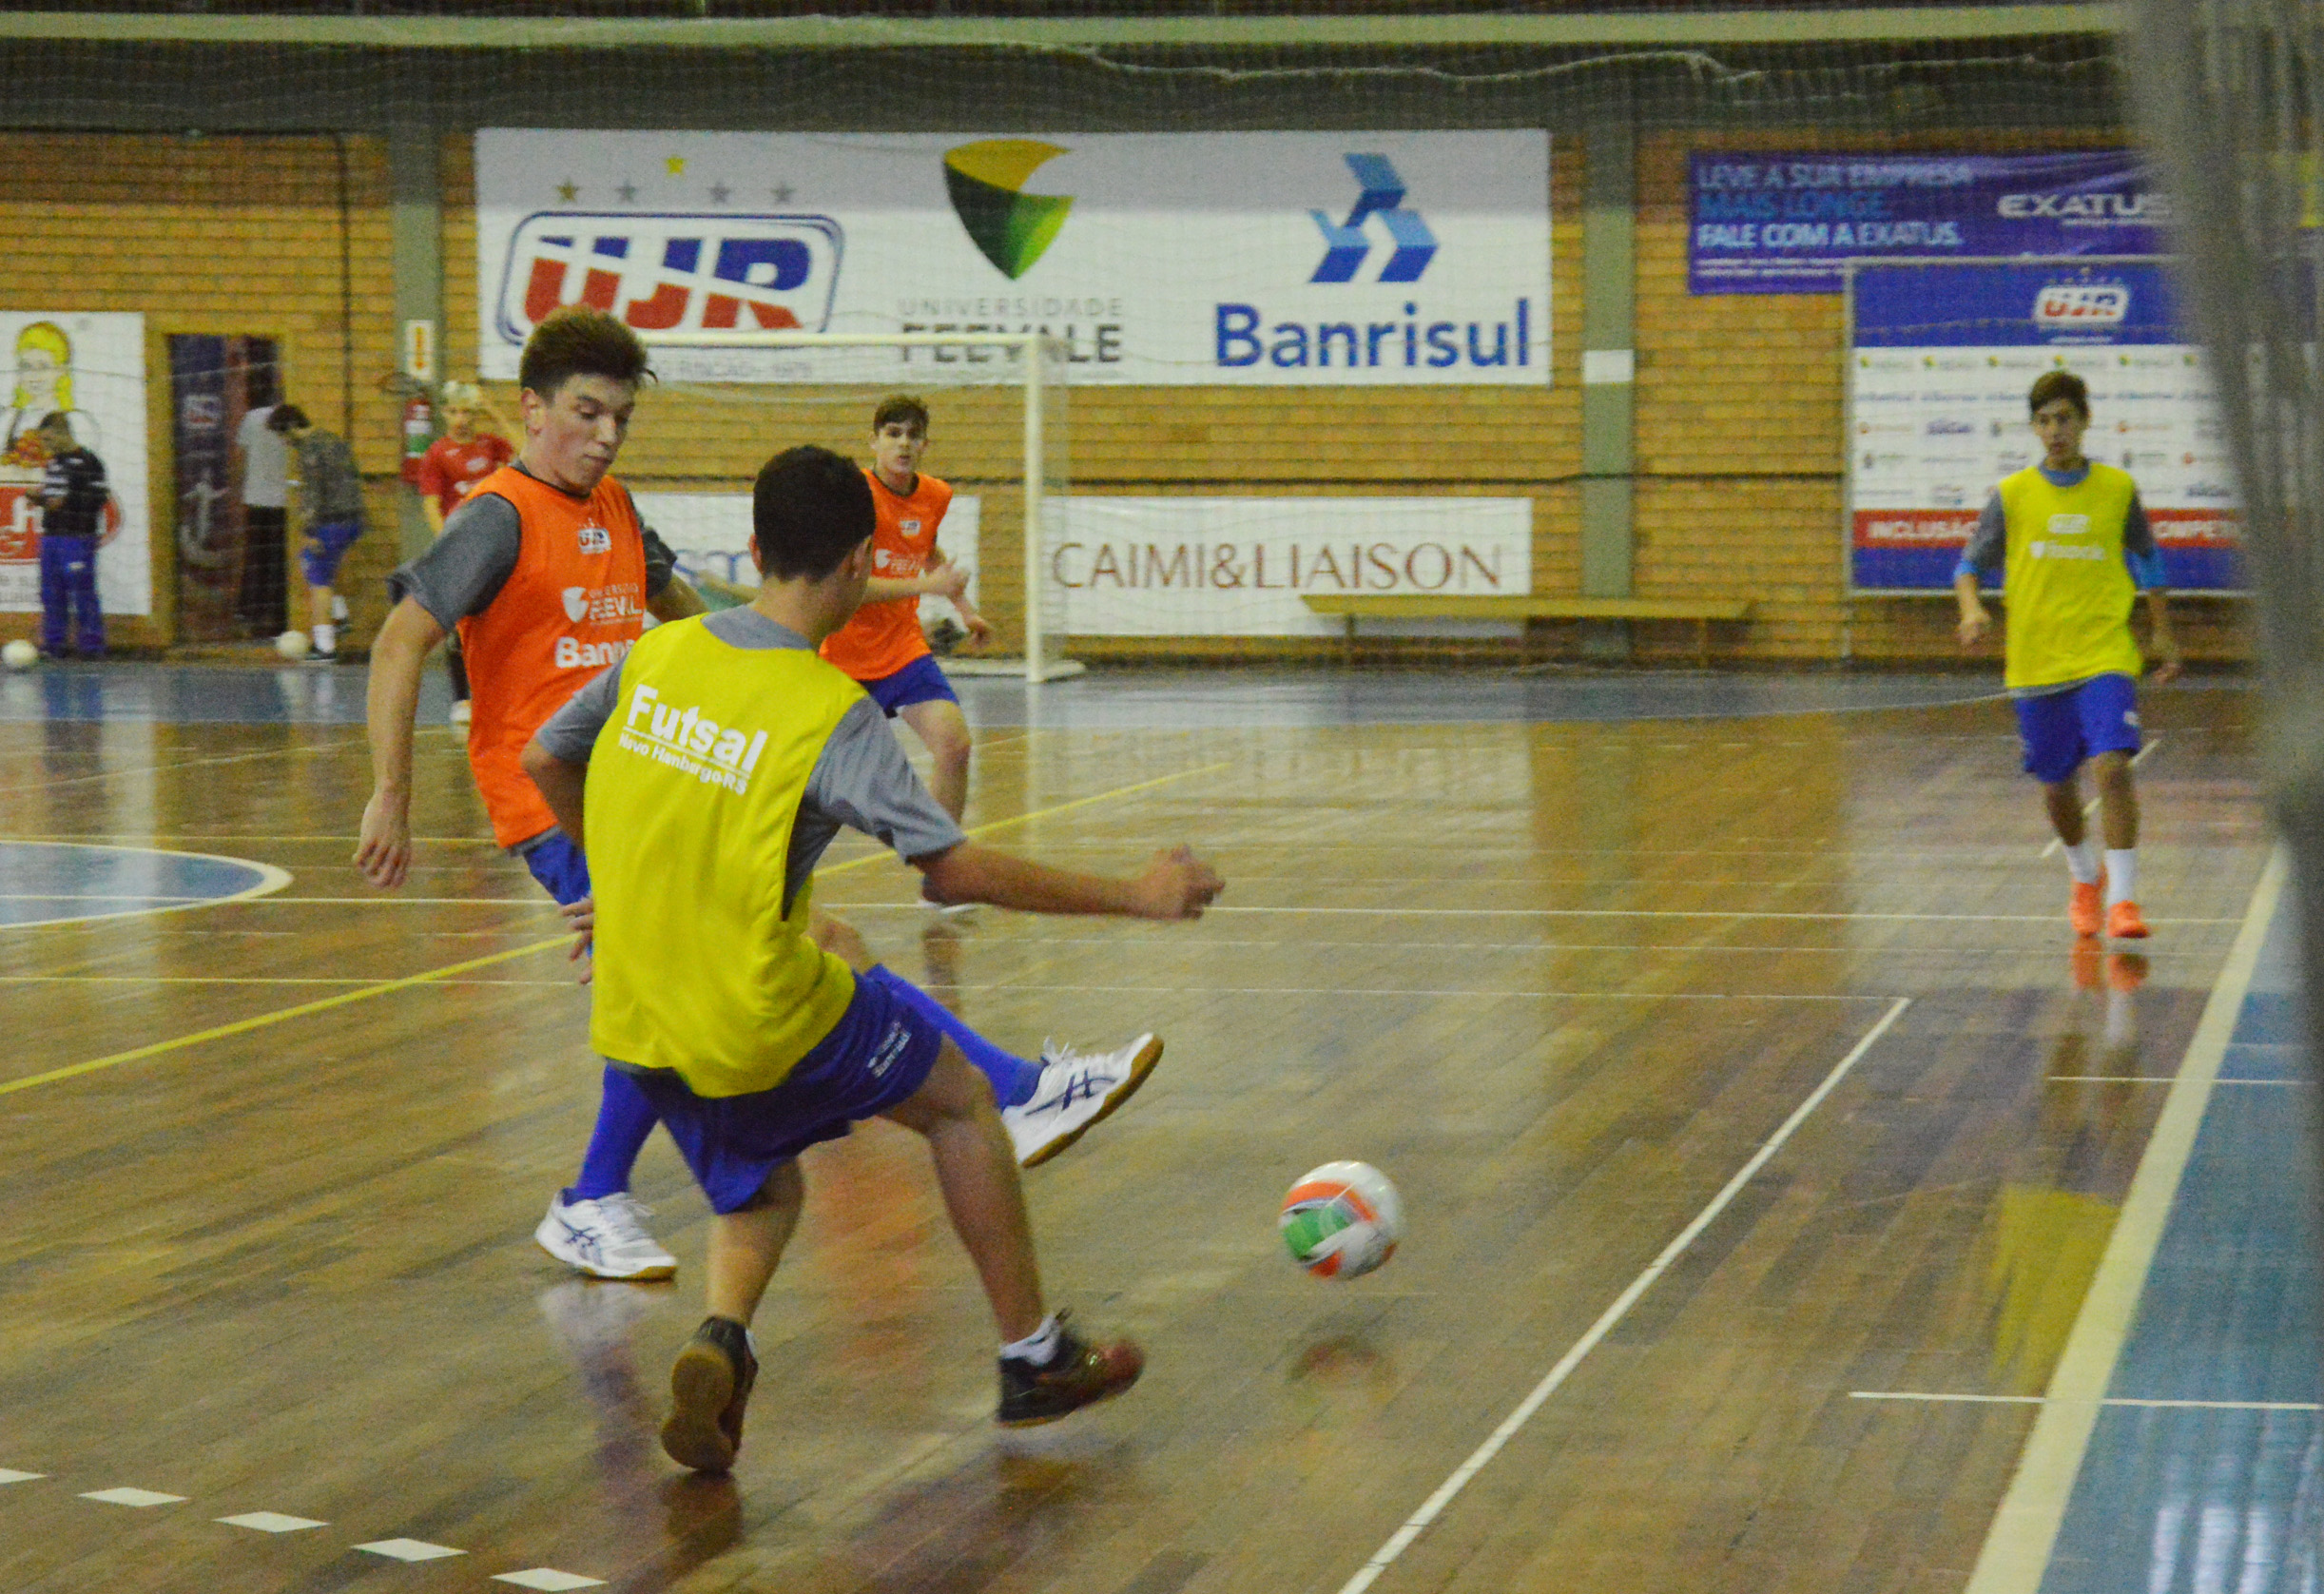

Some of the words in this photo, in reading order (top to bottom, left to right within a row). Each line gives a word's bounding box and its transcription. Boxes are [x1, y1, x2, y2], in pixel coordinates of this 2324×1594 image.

[523, 236, 812, 330] UJR
[897, 297, 1123, 317] UNIVERSIDADE
[1214, 298, 1530, 368] Banrisul
[1052, 542, 1501, 591] CAIMI&LIAISON
[619, 732, 649, 756] Novo
[627, 683, 768, 774] Futsal
